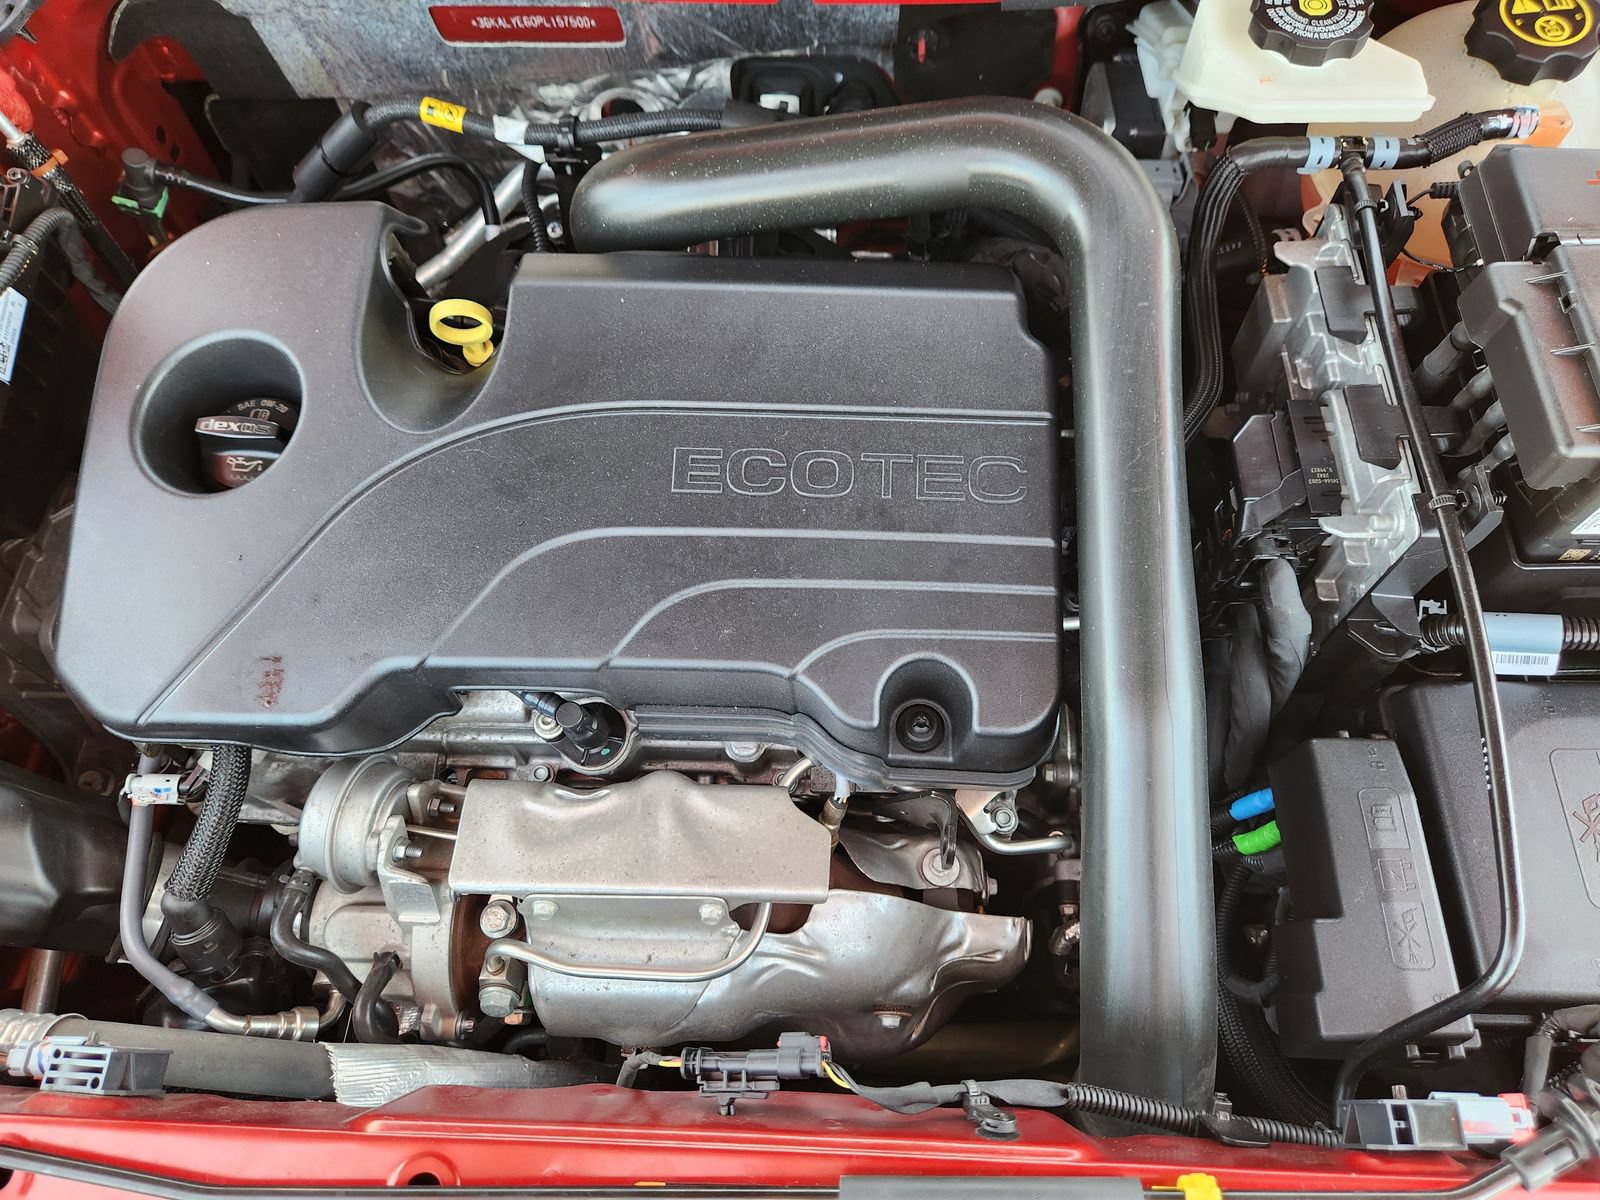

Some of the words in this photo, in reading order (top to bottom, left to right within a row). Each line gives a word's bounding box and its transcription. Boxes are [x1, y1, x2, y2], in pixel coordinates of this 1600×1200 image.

[1276, 18, 1294, 32] FLUID
[1293, 28, 1314, 39] FROM
[1320, 30, 1345, 39] SEALED
[1282, 16, 1307, 31] BEFORE
[1311, 19, 1334, 27] CLEAN
[237, 400, 256, 410] SAE
[671, 447, 1028, 503] ECOTEC
